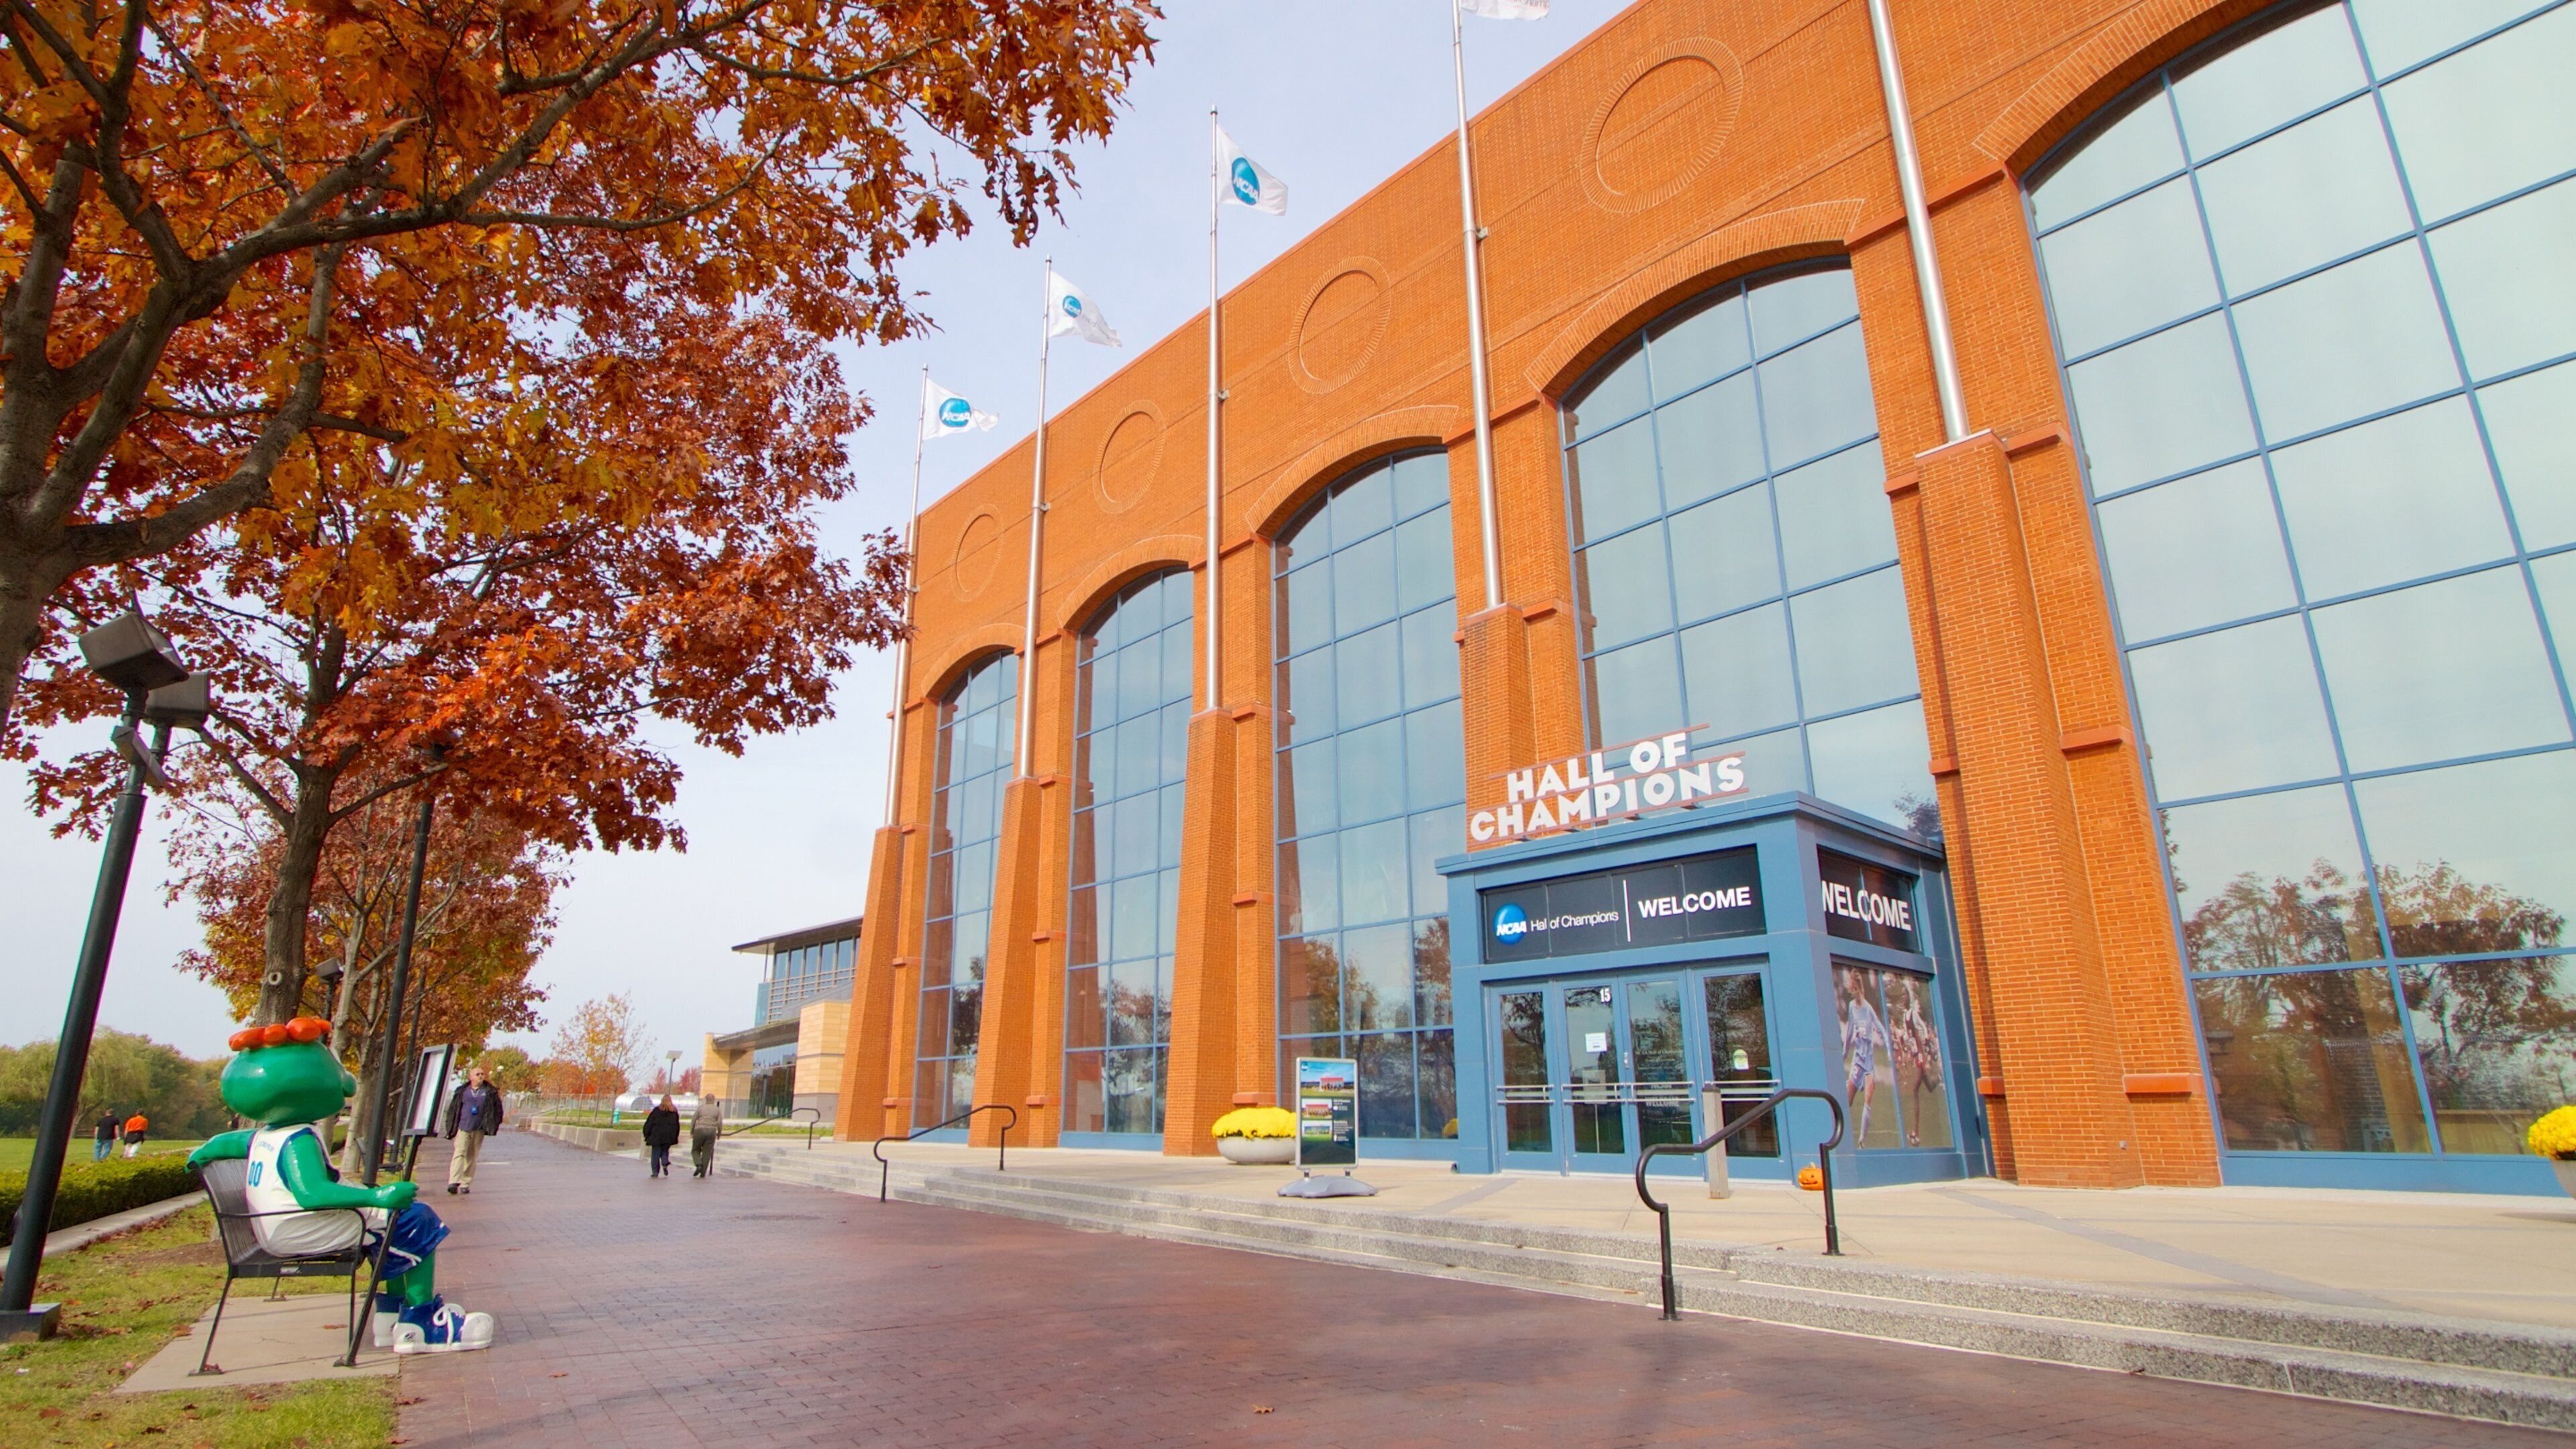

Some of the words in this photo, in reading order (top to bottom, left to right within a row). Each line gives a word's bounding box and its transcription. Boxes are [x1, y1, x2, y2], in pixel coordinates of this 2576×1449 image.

[1233, 176, 1259, 201] NCAA
[1507, 752, 1614, 803] HALL
[1630, 732, 1686, 774] OF
[1470, 757, 1745, 841] CHAMPIONS
[1638, 886, 1752, 918] WELCOME
[1496, 920, 1527, 936] NCAA
[1550, 916, 1560, 930] of
[1561, 910, 1619, 927] Champions
[1600, 987, 1611, 1003] 15
[248, 1161, 263, 1187] 00
